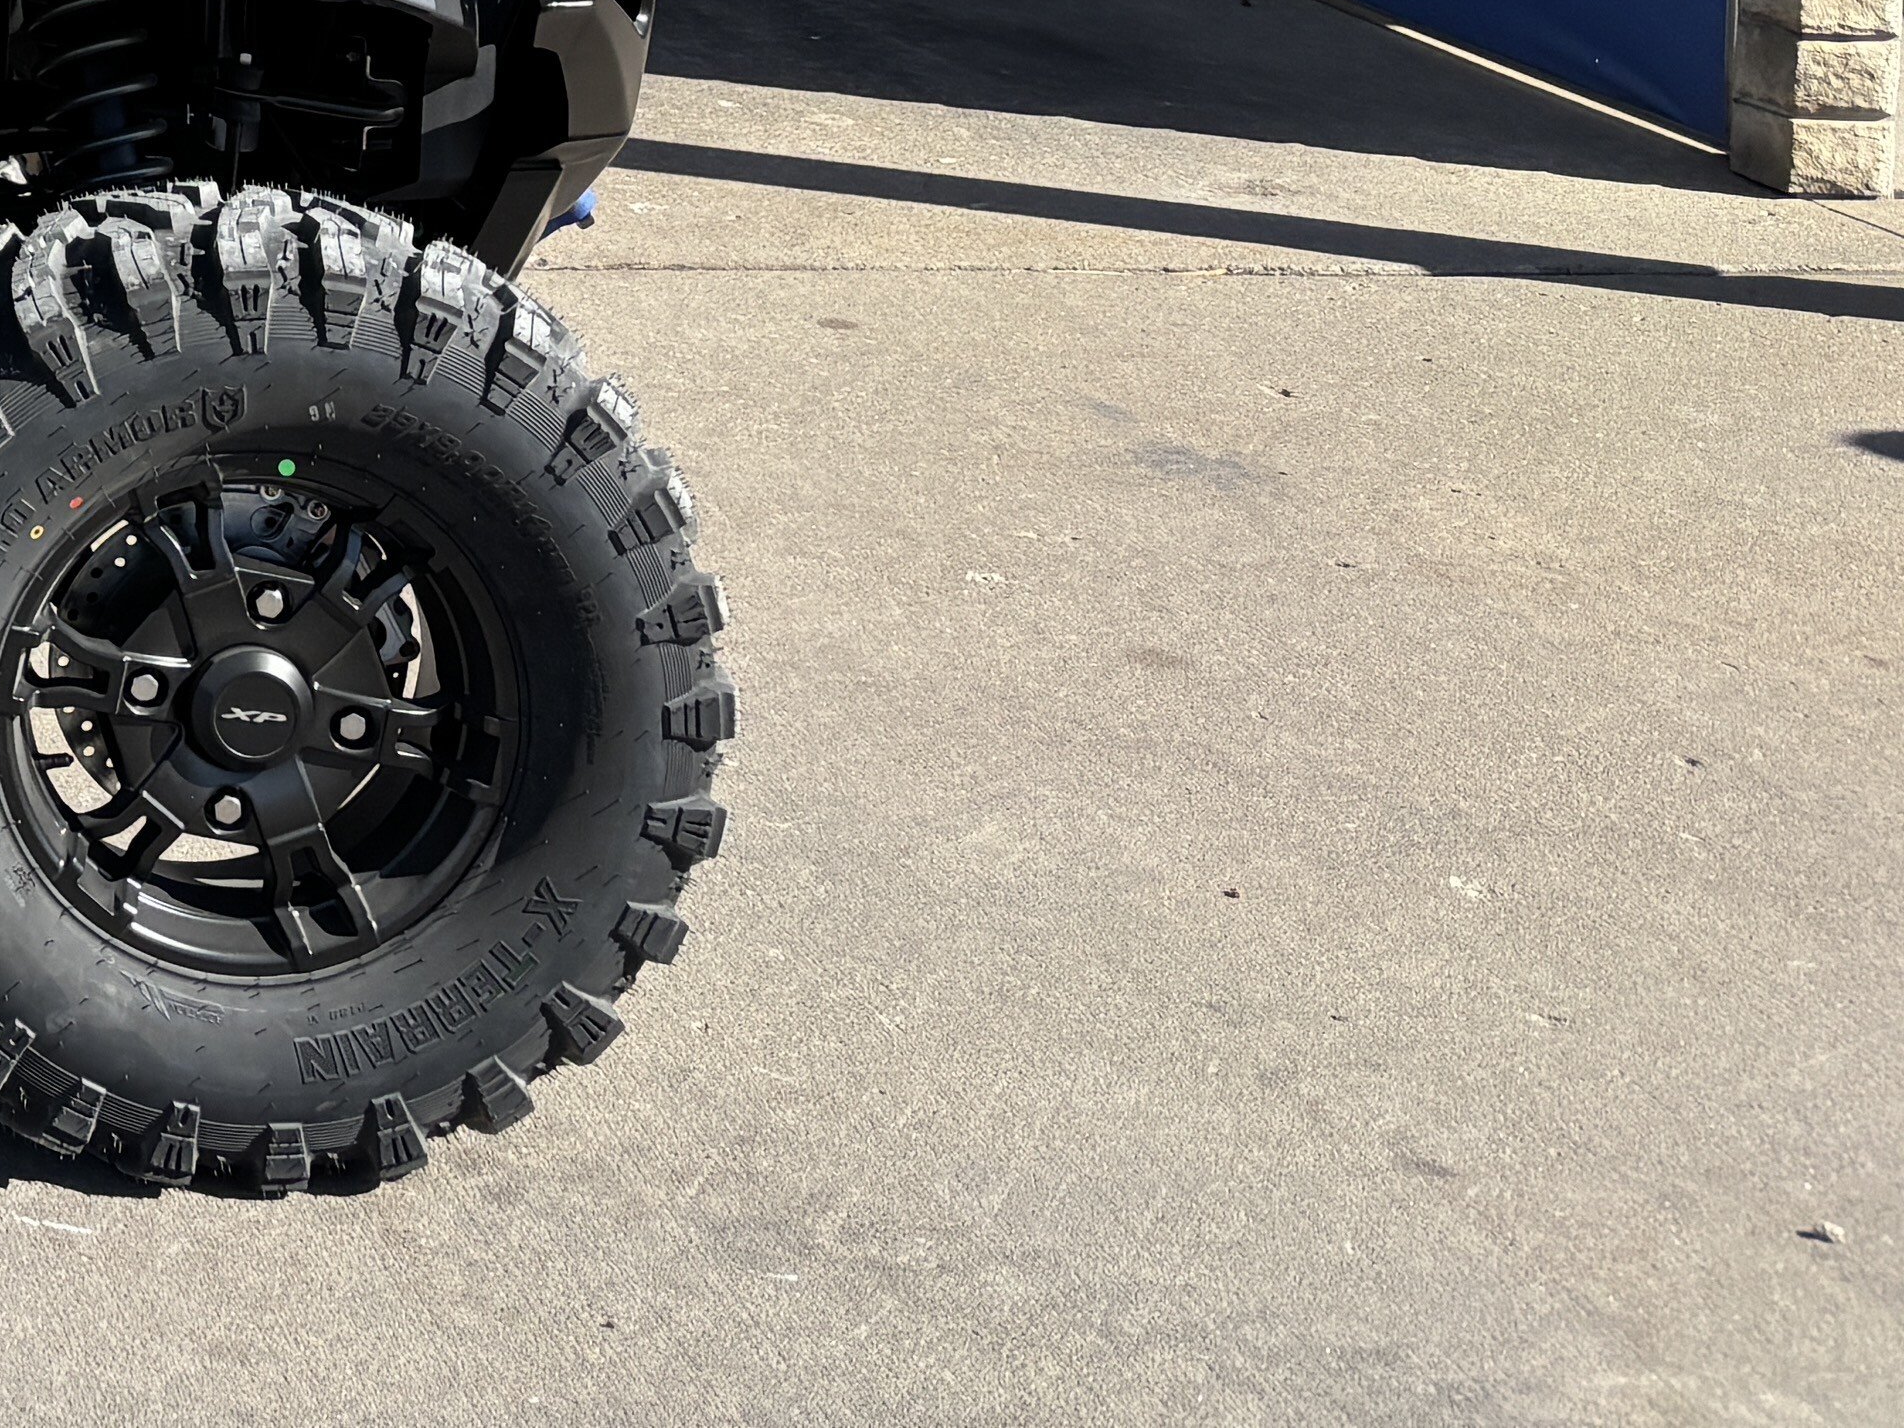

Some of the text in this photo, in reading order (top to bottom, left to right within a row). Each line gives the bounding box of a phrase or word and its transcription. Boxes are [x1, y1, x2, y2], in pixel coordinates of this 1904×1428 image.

[35, 392, 198, 501] ARMOR
[221, 706, 288, 725] XP
[292, 875, 584, 1086] X-TERRAIN
